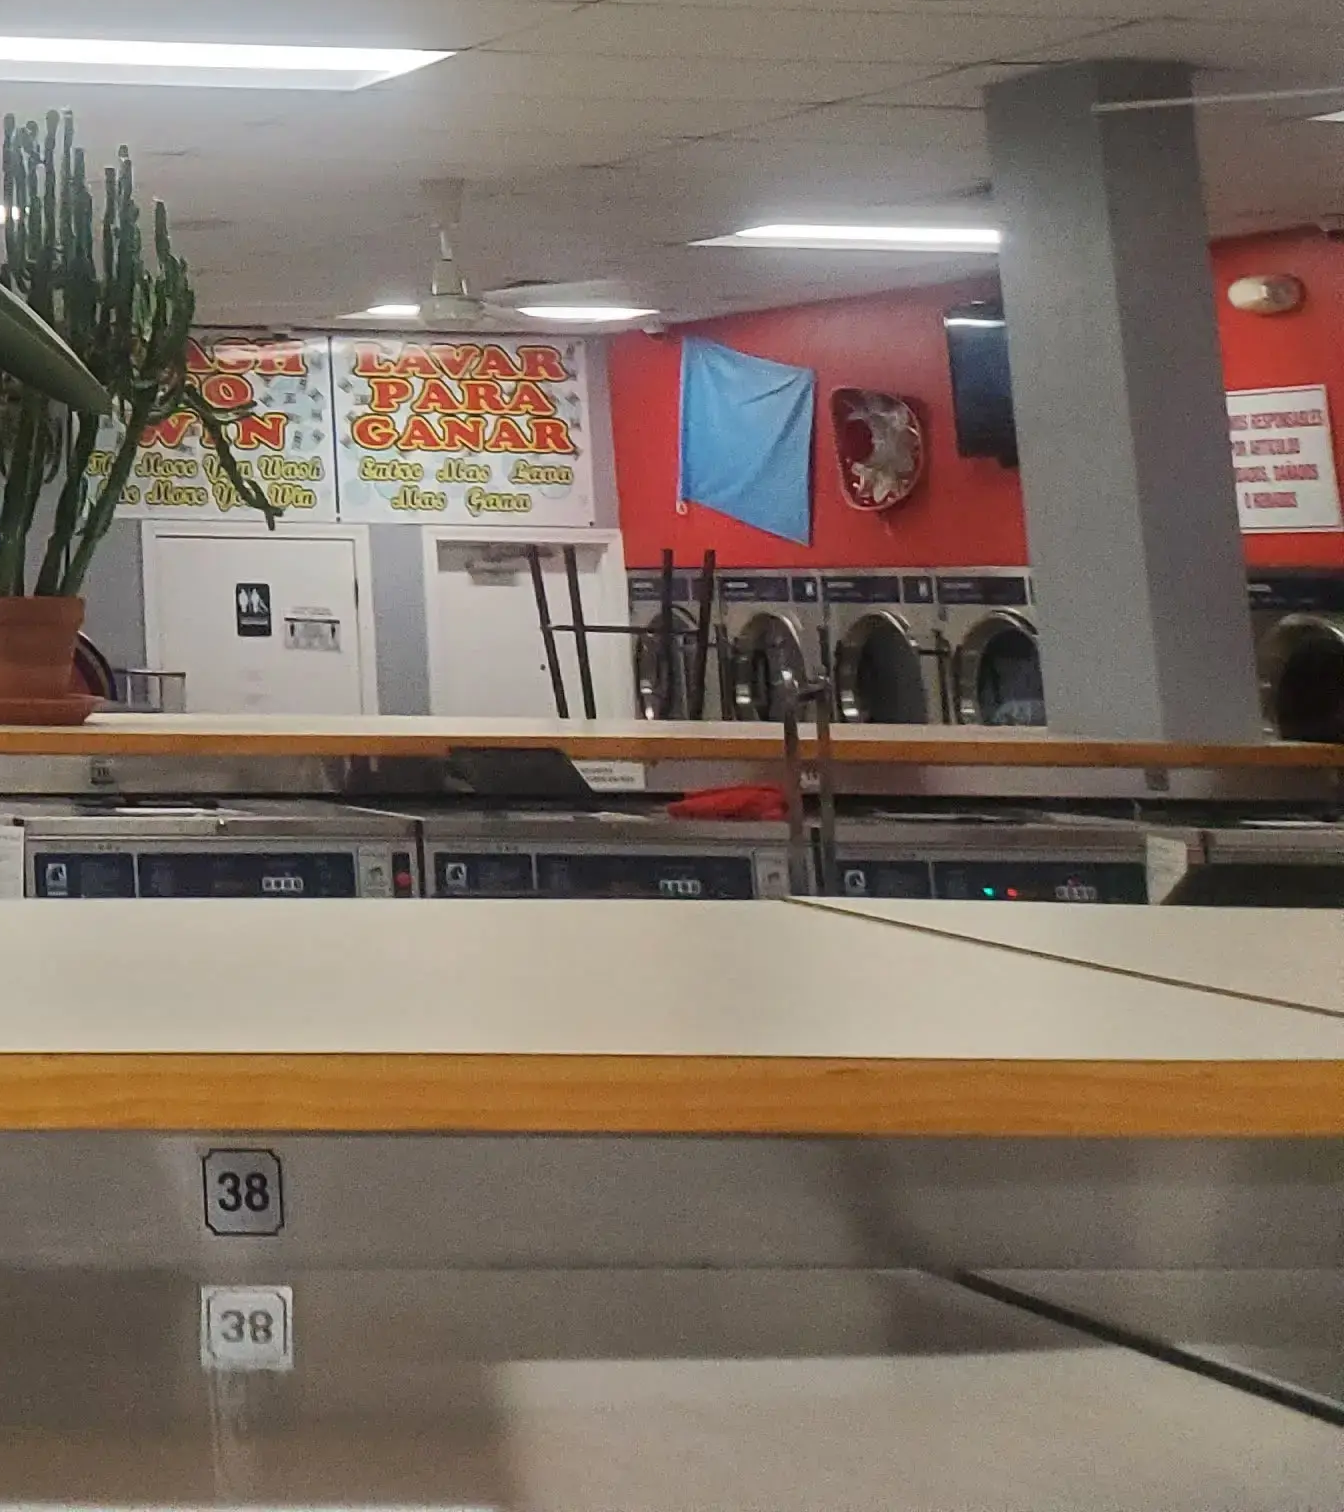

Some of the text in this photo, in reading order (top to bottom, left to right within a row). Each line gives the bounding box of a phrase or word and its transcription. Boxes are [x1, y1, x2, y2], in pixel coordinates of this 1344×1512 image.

[353, 341, 568, 381] LAVAR
[369, 378, 557, 415] PARA
[352, 414, 575, 454] GANAR
[359, 456, 423, 482] Entre
[436, 457, 492, 484] Mas
[391, 485, 532, 517] Mas Gana
[218, 1172, 269, 1212] 38
